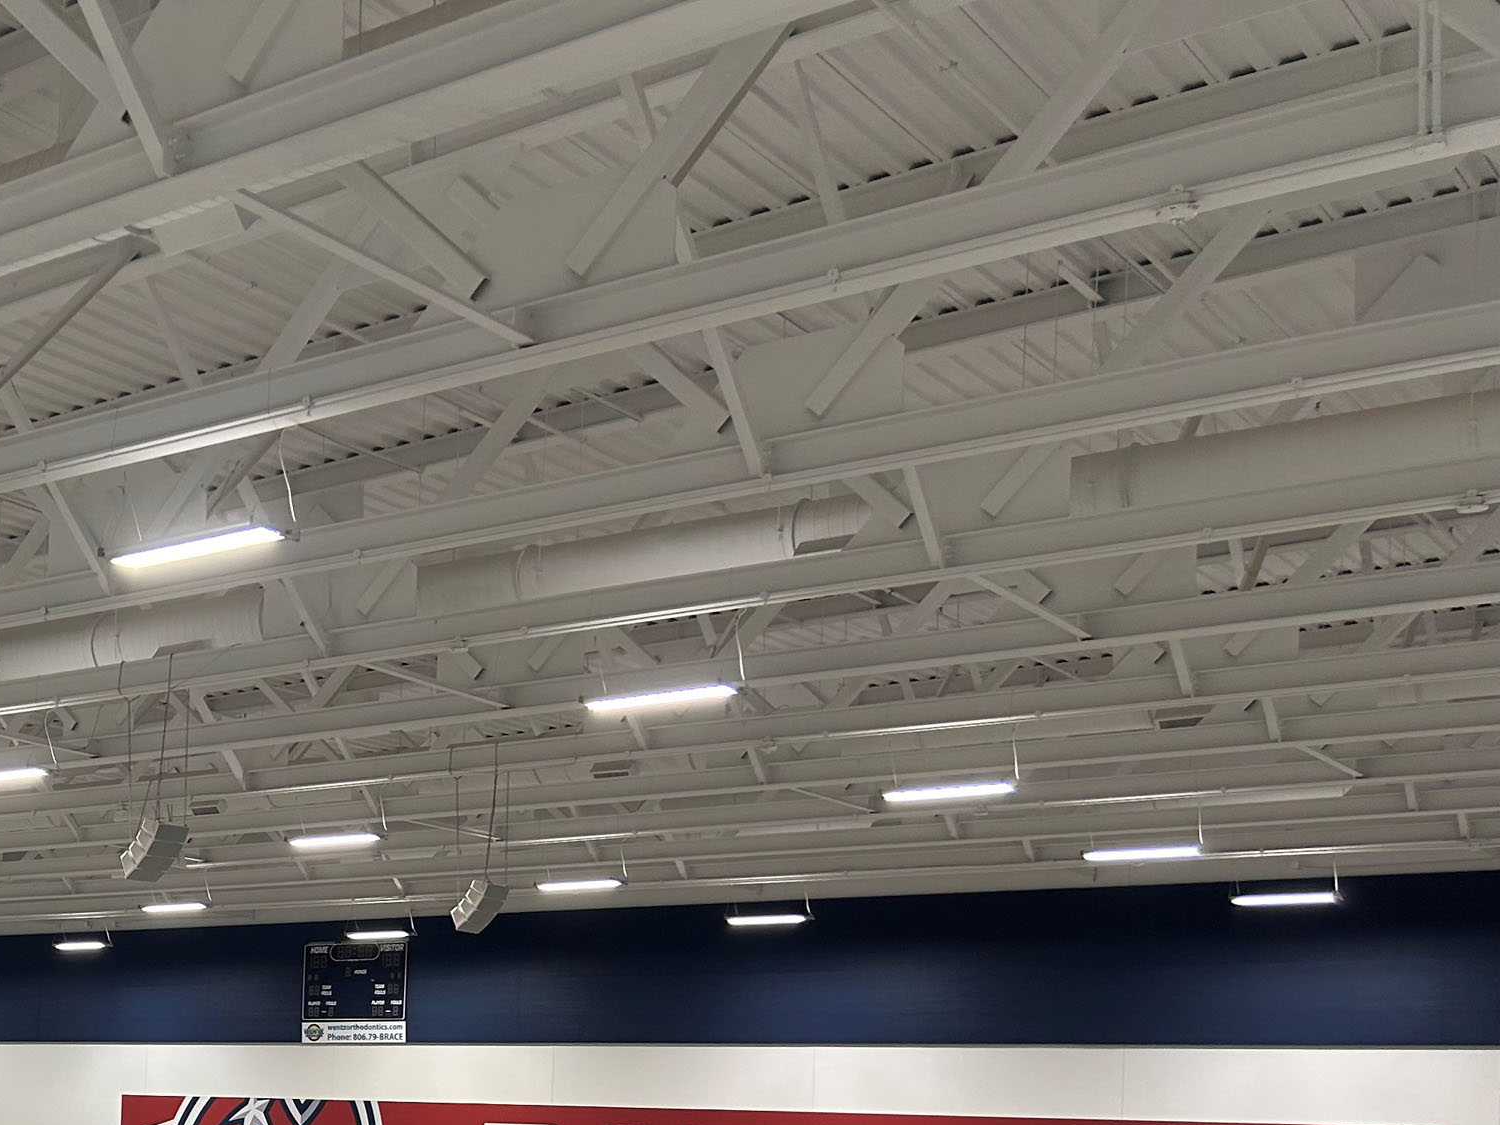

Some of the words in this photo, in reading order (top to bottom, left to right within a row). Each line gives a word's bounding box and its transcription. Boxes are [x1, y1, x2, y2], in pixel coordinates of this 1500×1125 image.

[380, 944, 404, 952] VISITOR
[327, 1023, 403, 1031] wentzorthodontics.com
[327, 1033, 352, 1041] Phone:
